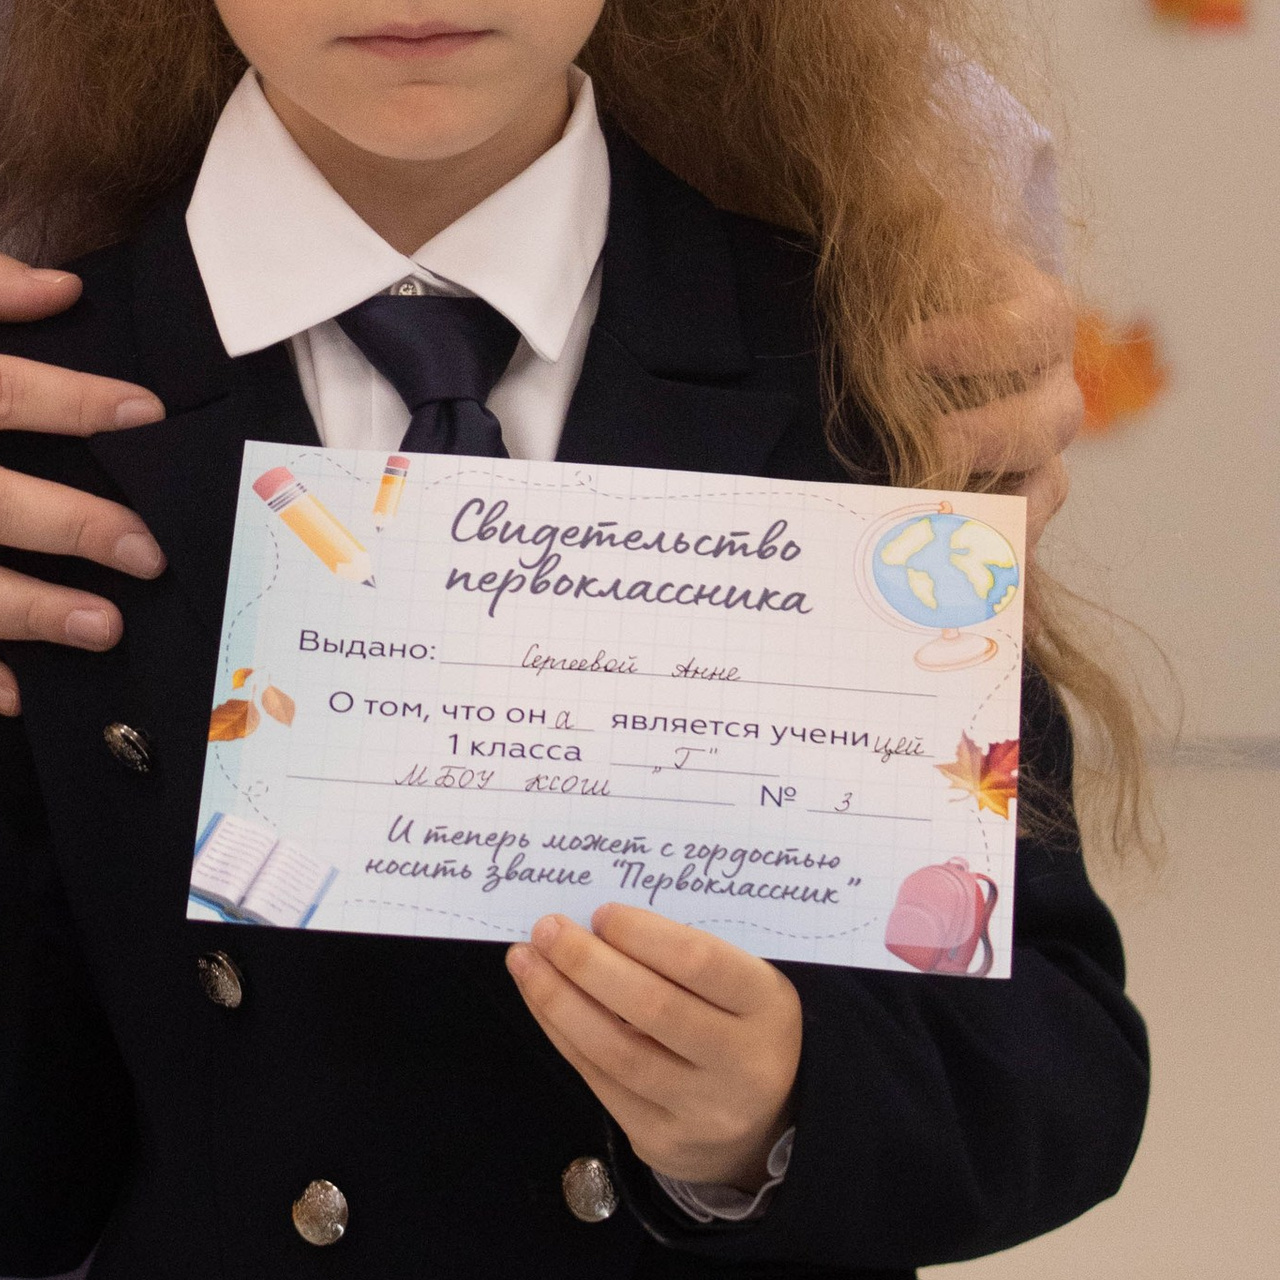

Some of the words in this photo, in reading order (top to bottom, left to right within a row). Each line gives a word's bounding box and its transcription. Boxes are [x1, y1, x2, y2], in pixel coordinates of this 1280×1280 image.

[450, 497, 802, 569] Свидетельство
[445, 553, 813, 617] первоклассника
[298, 629, 436, 661] Выдано:
[521, 643, 638, 676] Сергеевой
[671, 657, 741, 681] Анне
[328, 691, 354, 713] О
[364, 699, 430, 723] том,
[442, 704, 496, 722] что
[611, 713, 760, 739] является
[447, 733, 459, 754] 1
[470, 740, 583, 762] класса
[760, 784, 798, 808] №
[834, 792, 854, 813] 3
[365, 856, 473, 881] носить
[481, 852, 594, 893] звание
[387, 814, 411, 845] И
[422, 825, 530, 864] теперь
[542, 834, 654, 855] может
[660, 841, 675, 859] с
[684, 842, 842, 881] гордостью
